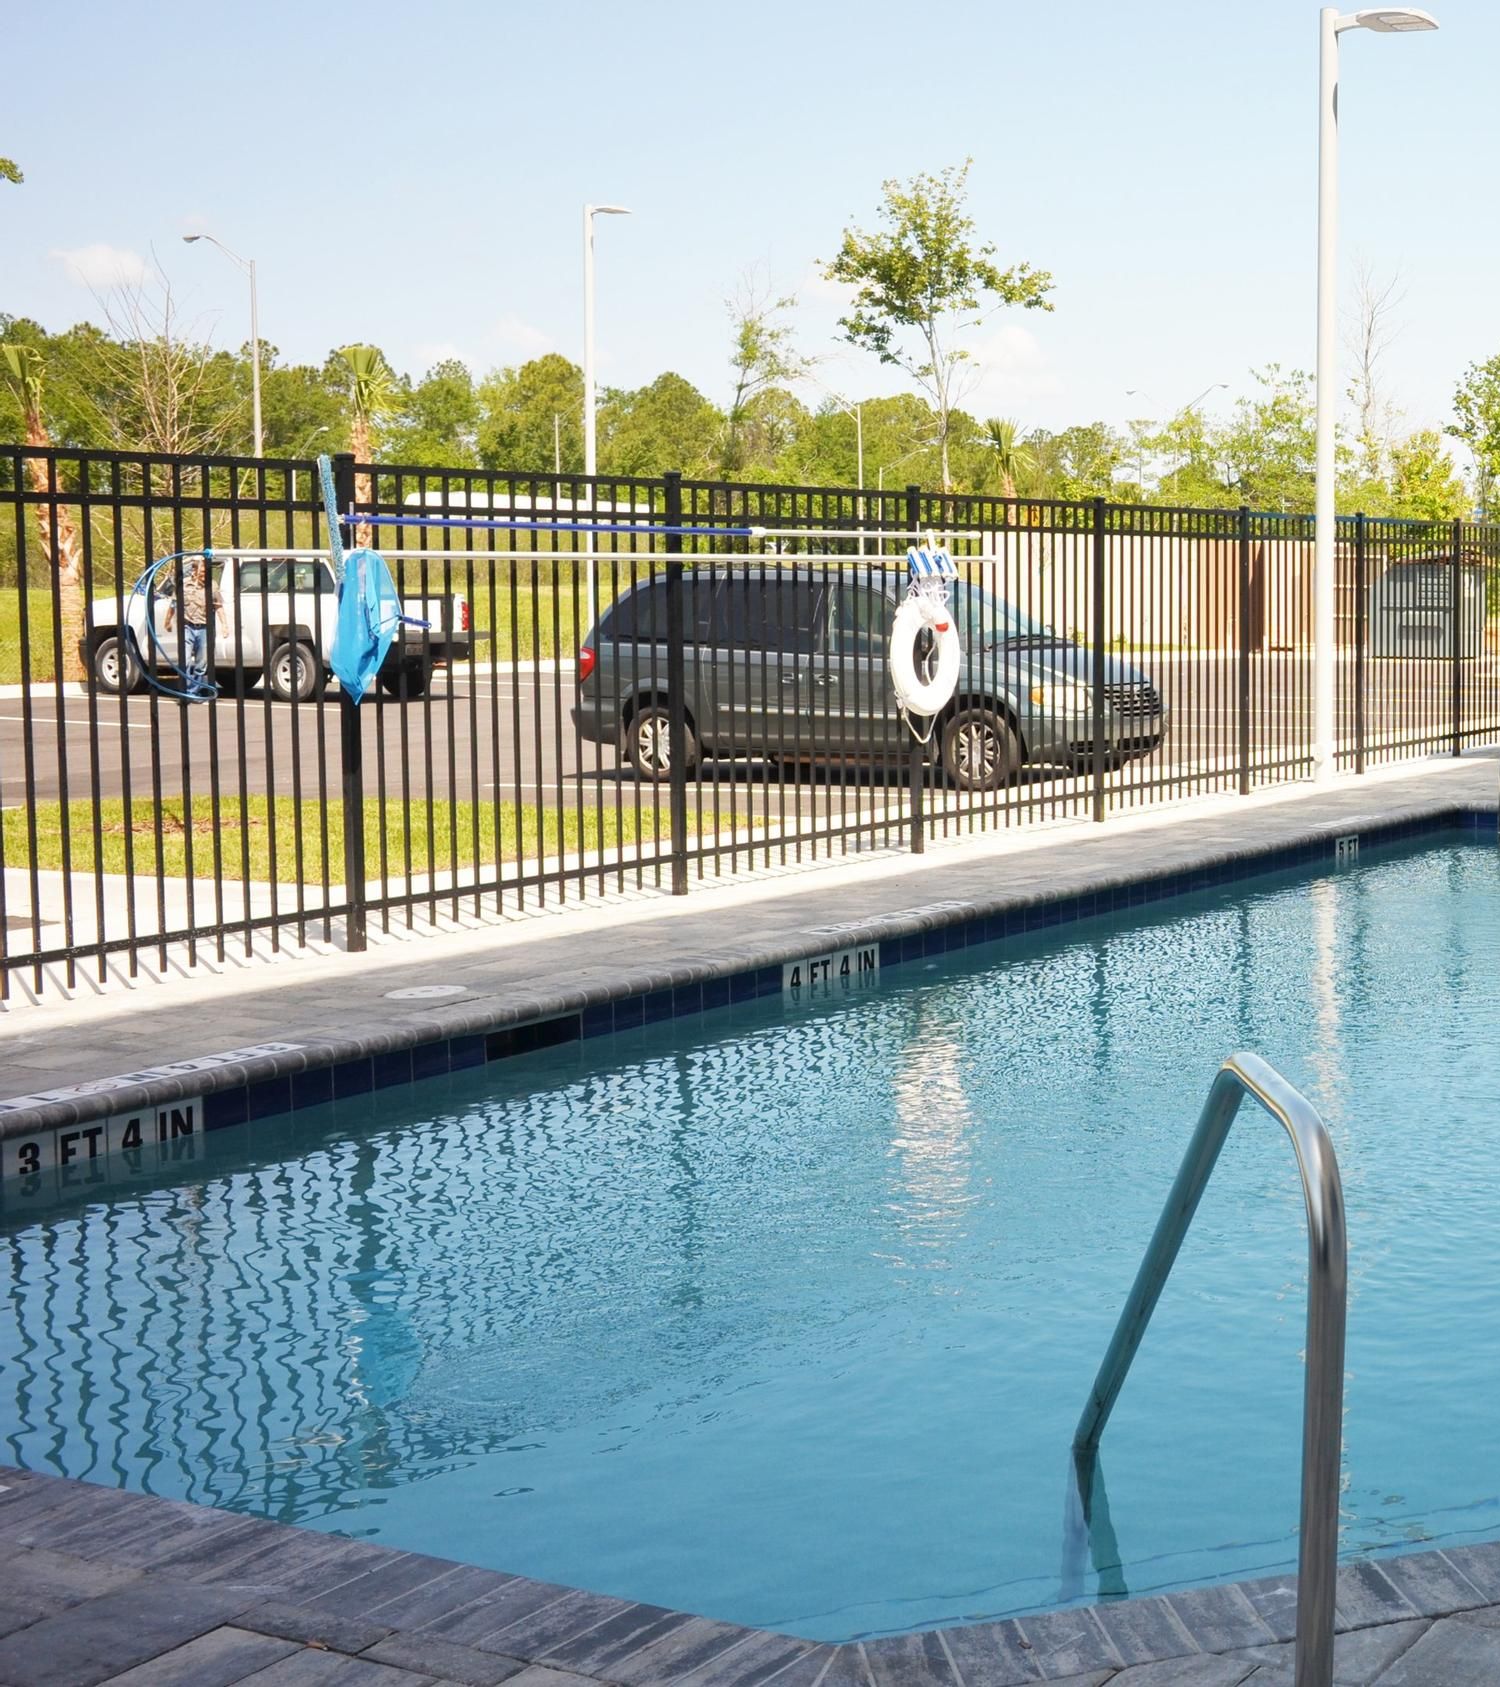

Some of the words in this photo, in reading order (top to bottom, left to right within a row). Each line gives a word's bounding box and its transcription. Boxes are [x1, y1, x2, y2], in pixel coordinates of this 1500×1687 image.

[1339, 841, 1345, 857] 5
[790, 966, 802, 988] 4
[810, 959, 831, 984] FT
[840, 955, 851, 976] 4
[858, 949, 875, 972] IN
[18, 1142, 42, 1175] 3
[60, 1126, 104, 1166] FT
[121, 1118, 144, 1149] 4
[159, 1105, 194, 1142] IN
